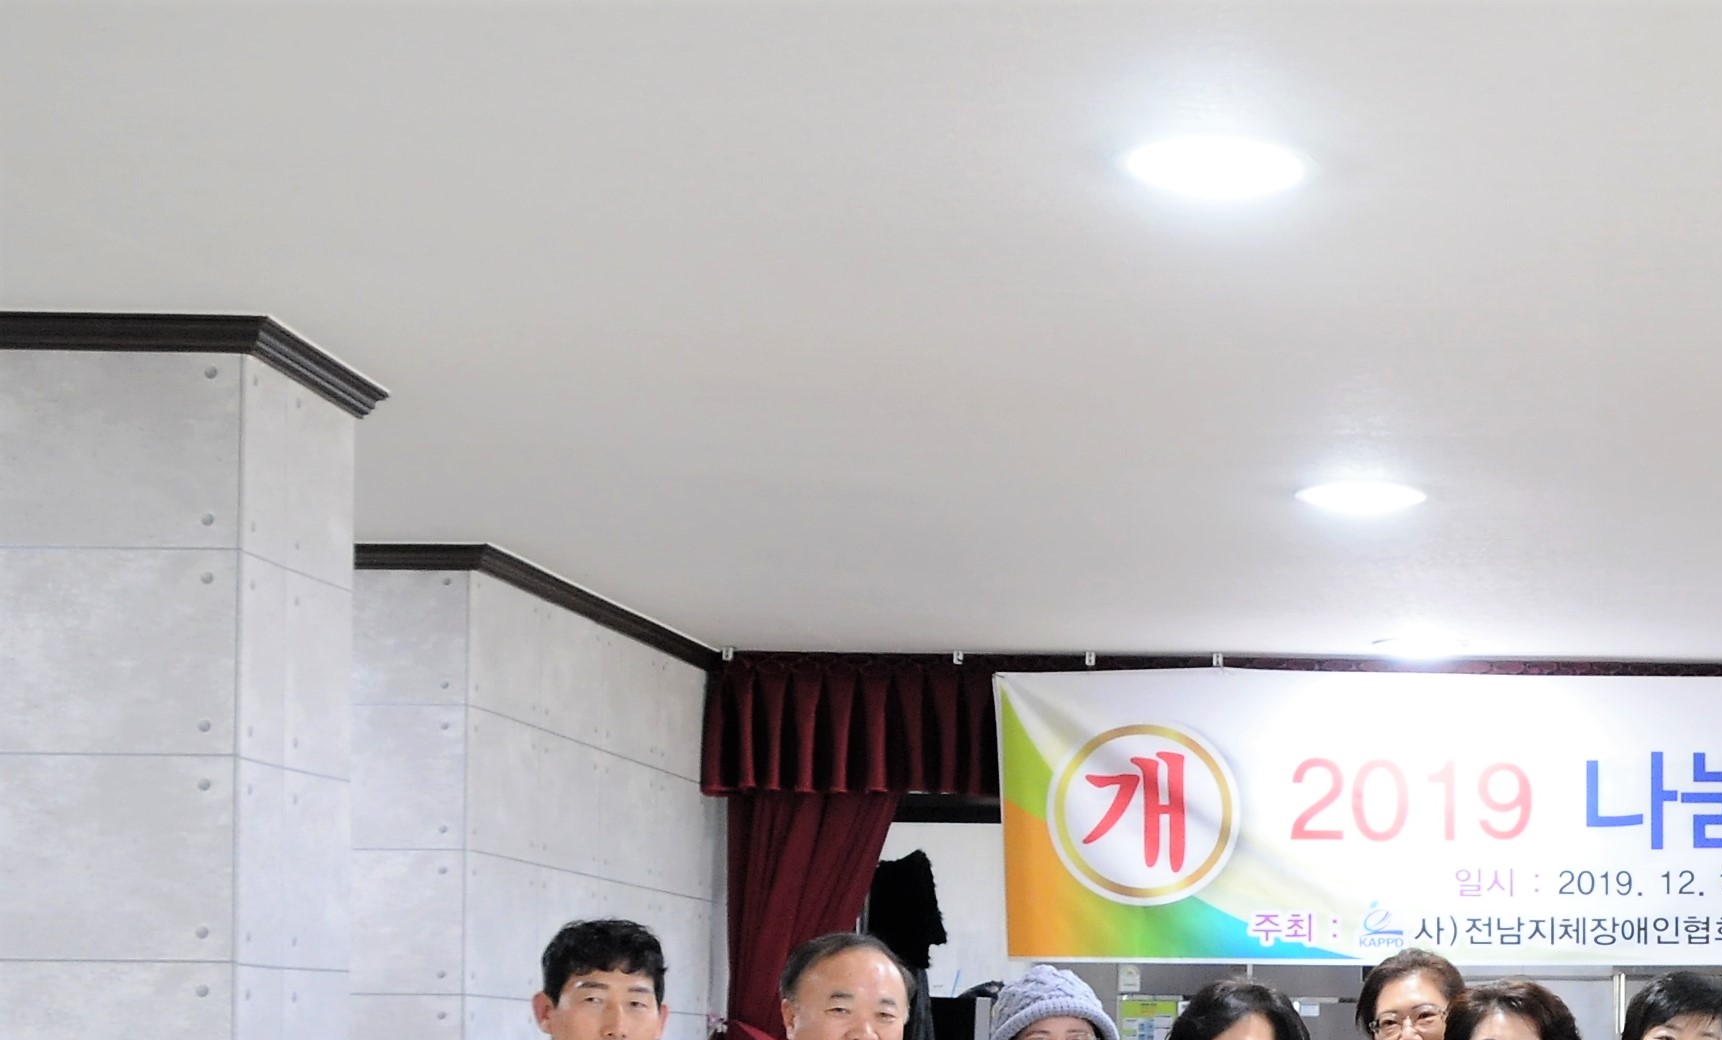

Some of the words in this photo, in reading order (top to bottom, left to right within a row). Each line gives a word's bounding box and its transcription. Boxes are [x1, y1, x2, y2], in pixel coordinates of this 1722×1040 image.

[1083, 749, 1184, 874] 개
[1289, 756, 1532, 843] 2019
[1455, 868, 1514, 897] 일시
[1558, 869, 1643, 897] 2019.
[1661, 869, 1704, 897] 12.
[1251, 913, 1313, 943] 주최
[1359, 937, 1404, 949] KAPPD
